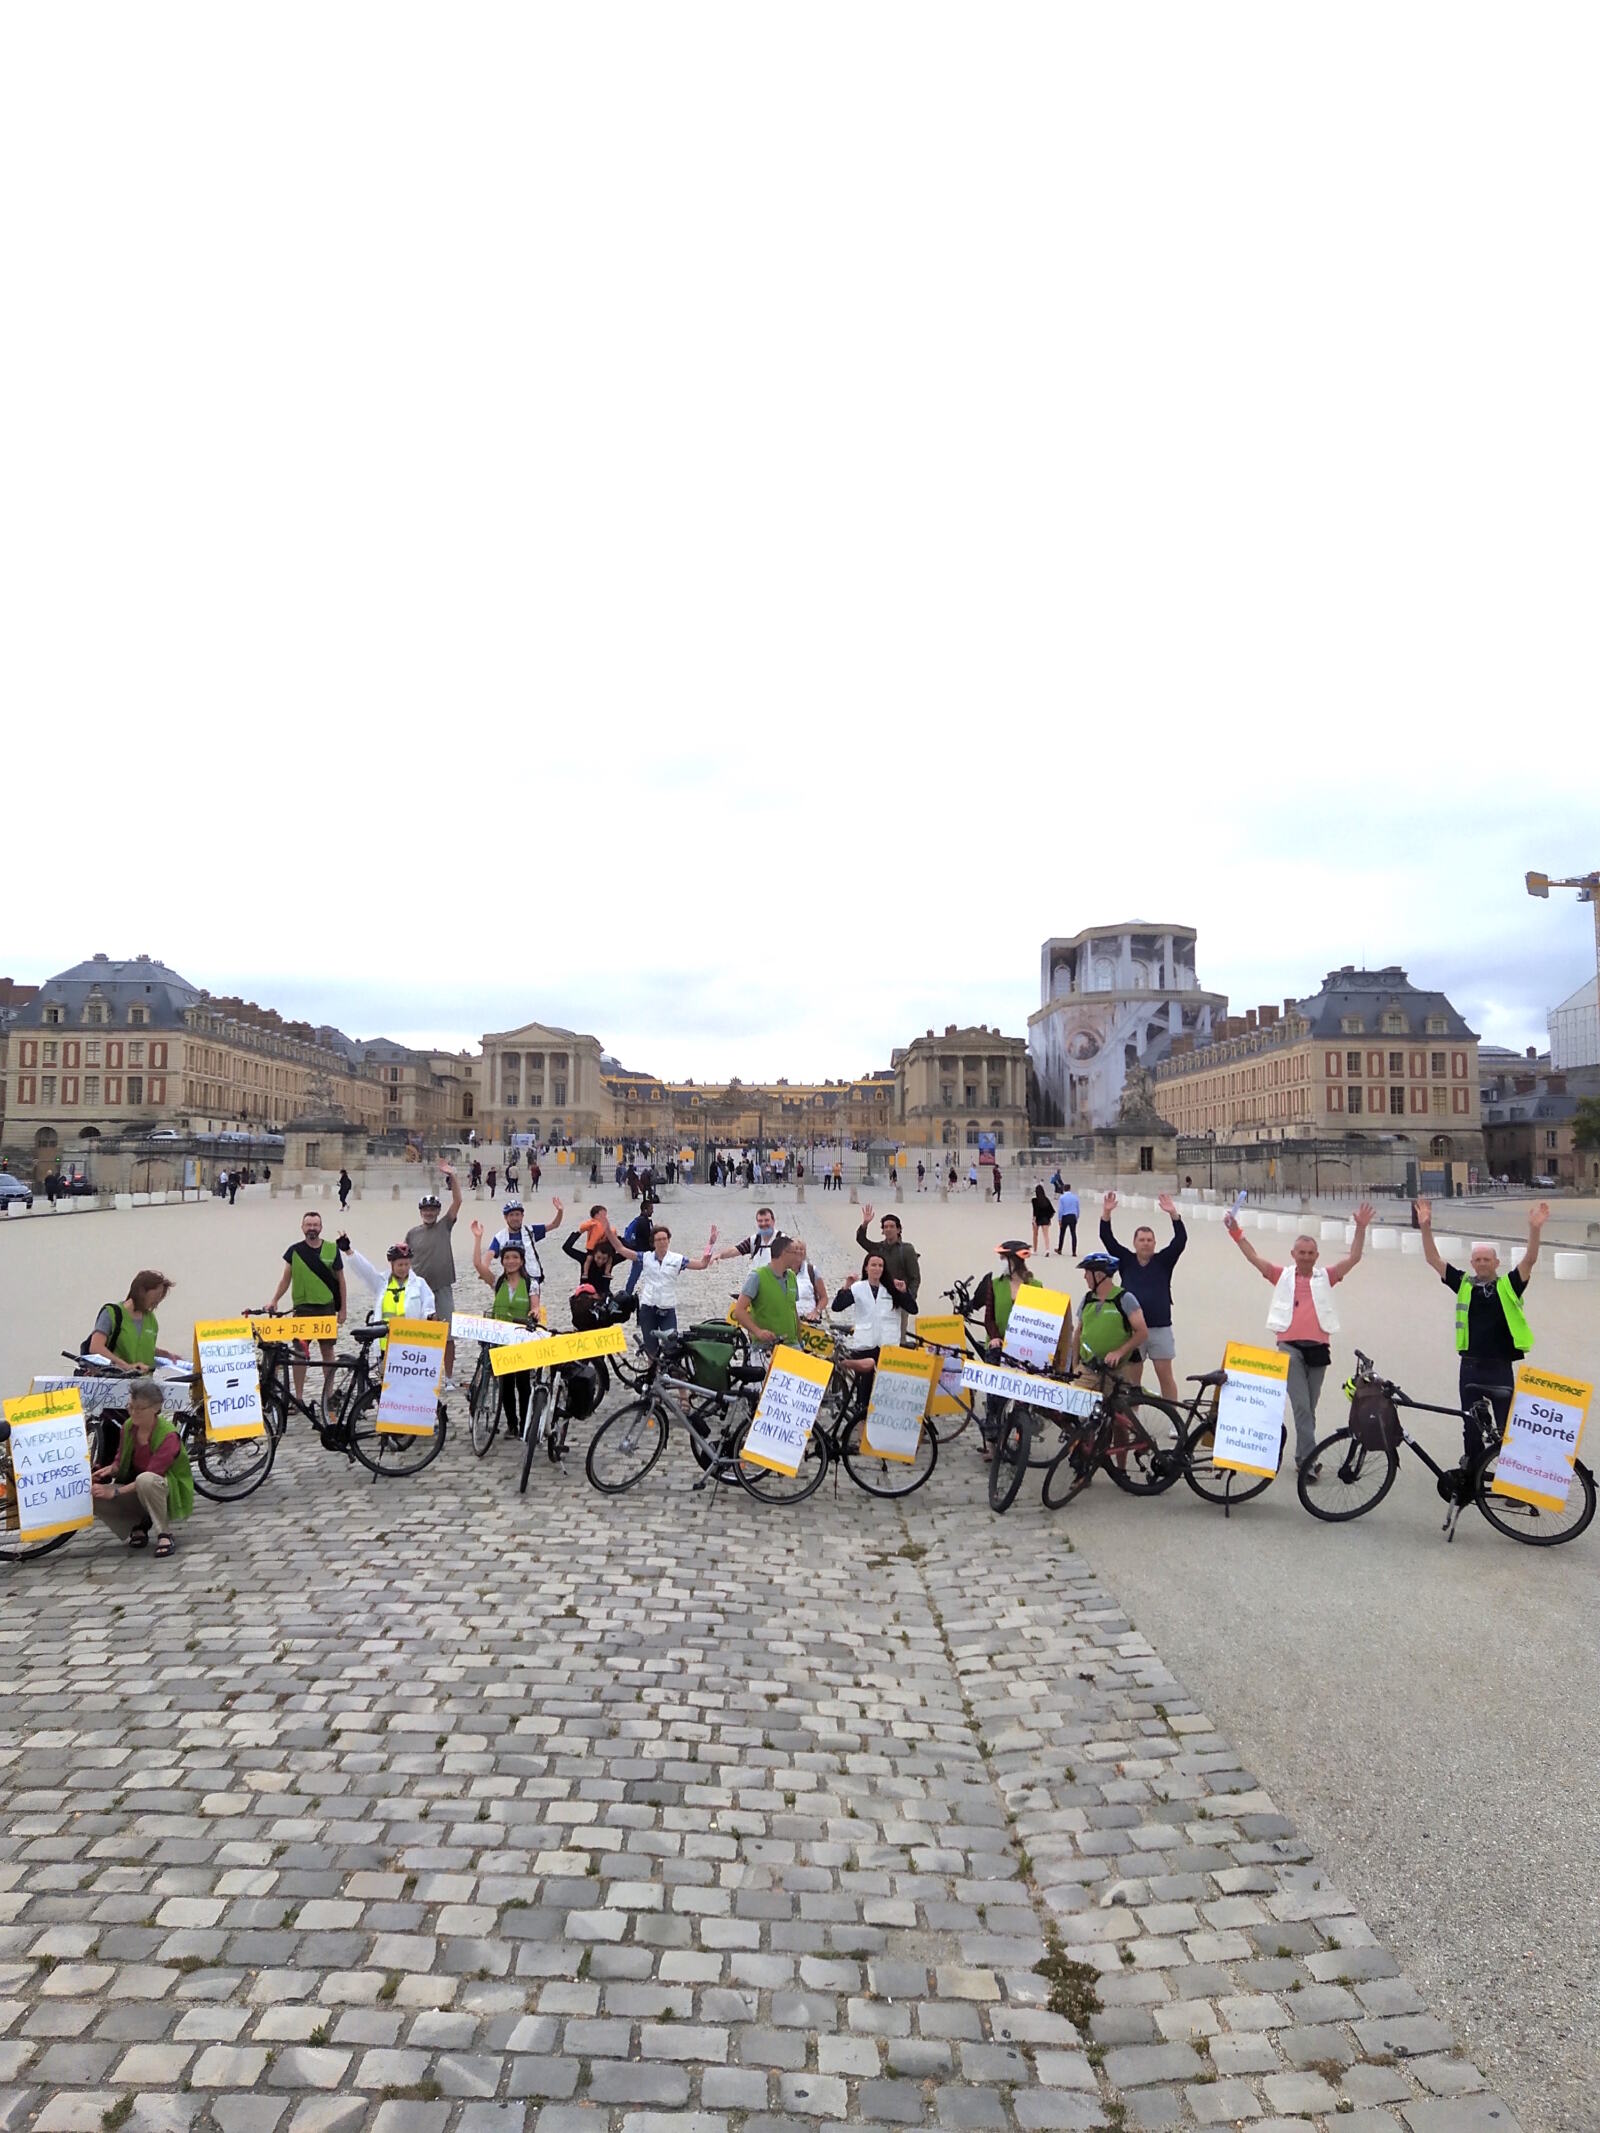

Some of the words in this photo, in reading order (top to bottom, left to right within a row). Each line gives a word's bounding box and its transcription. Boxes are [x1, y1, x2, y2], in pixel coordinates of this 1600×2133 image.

[292, 1323, 305, 1334] DE
[1013, 1313, 1055, 1331] interdisez
[401, 1350, 427, 1364] Soja
[535, 1347, 559, 1359] UNE
[566, 1338, 590, 1353] PAC
[1019, 1347, 1033, 1357] en
[388, 1363, 437, 1378] importé
[780, 1375, 794, 1392] DE
[876, 1375, 910, 1394] POUR
[962, 1366, 984, 1385] POUR
[984, 1372, 998, 1388] UN
[999, 1375, 1023, 1396] JOUR
[1520, 1374, 1587, 1398] GREENPEACE
[209, 1395, 256, 1415] EMPLOIS
[380, 1400, 437, 1415] déforestation
[766, 1388, 788, 1405] SANS
[791, 1399, 818, 1415] VIANDE
[1235, 1394, 1248, 1404] au
[766, 1405, 791, 1424] DANS
[795, 1415, 811, 1429] LES
[1530, 1403, 1564, 1423] Soja
[13, 1438, 23, 1450] A
[24, 1426, 84, 1448] VERSAILLES
[753, 1420, 804, 1447] CANTINES
[1219, 1422, 1238, 1433] non
[1239, 1424, 1246, 1435] à
[1512, 1414, 1575, 1443] importé
[1226, 1436, 1268, 1454] industrie
[21, 1455, 32, 1469] A
[38, 1446, 75, 1464] VELO
[17, 1475, 35, 1490] ON
[36, 1463, 81, 1486] DEPASSE
[1499, 1457, 1572, 1485] déforestation
[24, 1491, 48, 1508] LES
[54, 1478, 91, 1501] AUTOS
